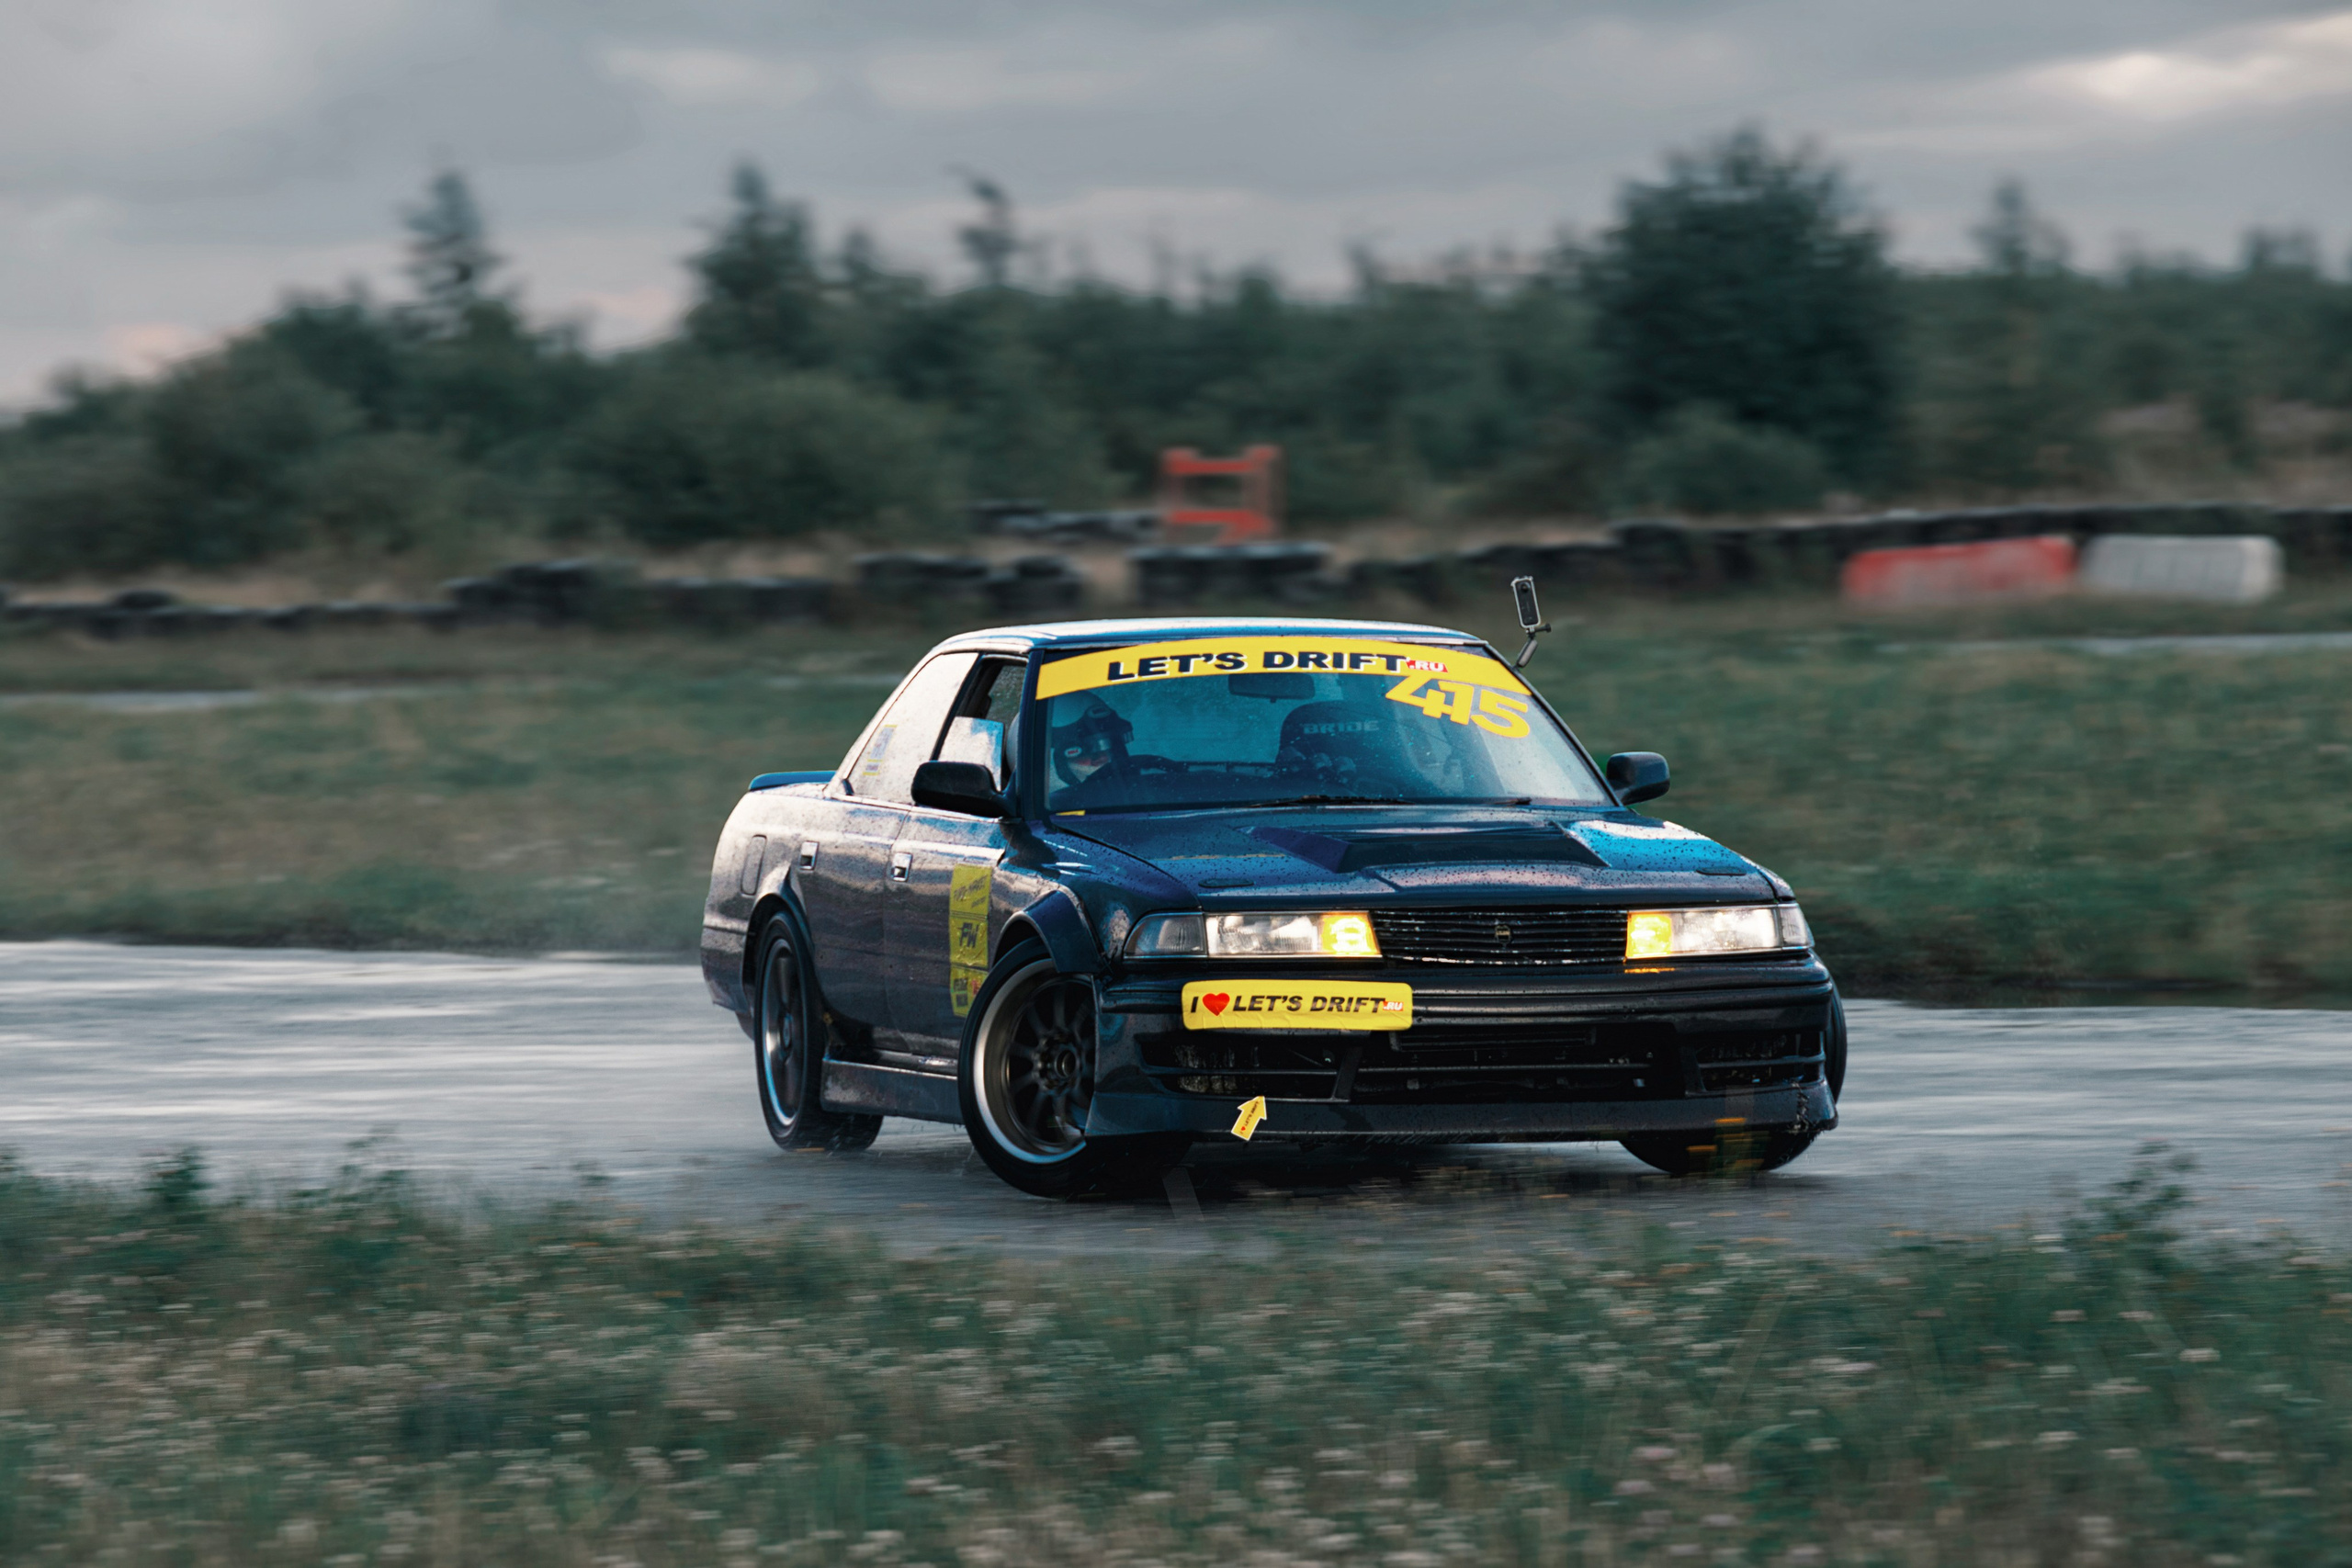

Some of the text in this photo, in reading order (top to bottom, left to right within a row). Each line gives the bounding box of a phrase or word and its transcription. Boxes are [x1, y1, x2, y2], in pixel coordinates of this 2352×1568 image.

[1107, 652, 1248, 682] LET'S
[1385, 676, 1531, 739] 415
[1303, 720, 1380, 735] BRIDE
[1191, 996, 1199, 1013] I
[1233, 996, 1303, 1012] LET'S
